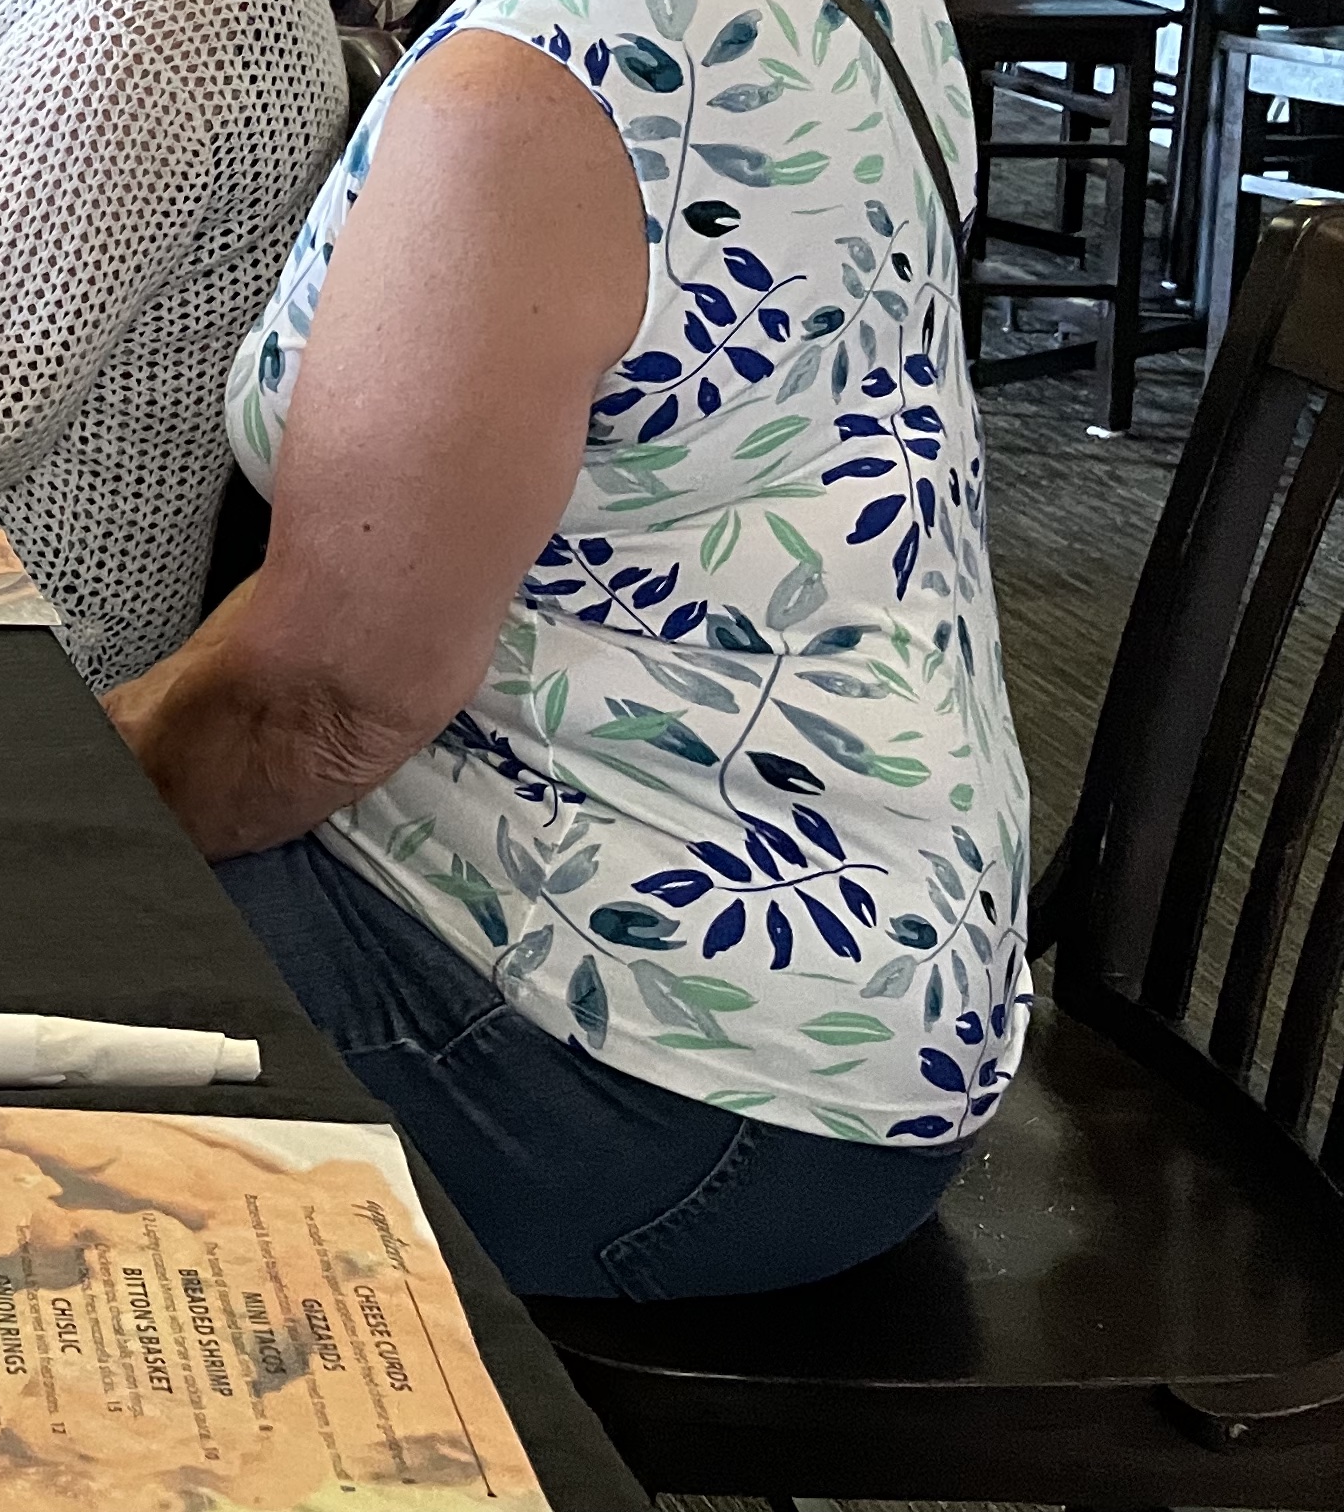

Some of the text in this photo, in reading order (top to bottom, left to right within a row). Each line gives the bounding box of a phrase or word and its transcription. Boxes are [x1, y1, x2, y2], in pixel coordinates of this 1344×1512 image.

[49, 1297, 82, 1354] CHISLIC
[121, 1267, 173, 1394] BITTON'S BASKET
[177, 1269, 234, 1396] BREADED SHRIMP
[240, 1292, 271, 1325] MINI
[299, 1298, 346, 1370] GIZZARDS
[352, 1285, 391, 1336] CHEESE
[373, 1340, 413, 1391] CURDS
[252, 1328, 287, 1373] TACOS
[50, 1422, 67, 1434] 12
